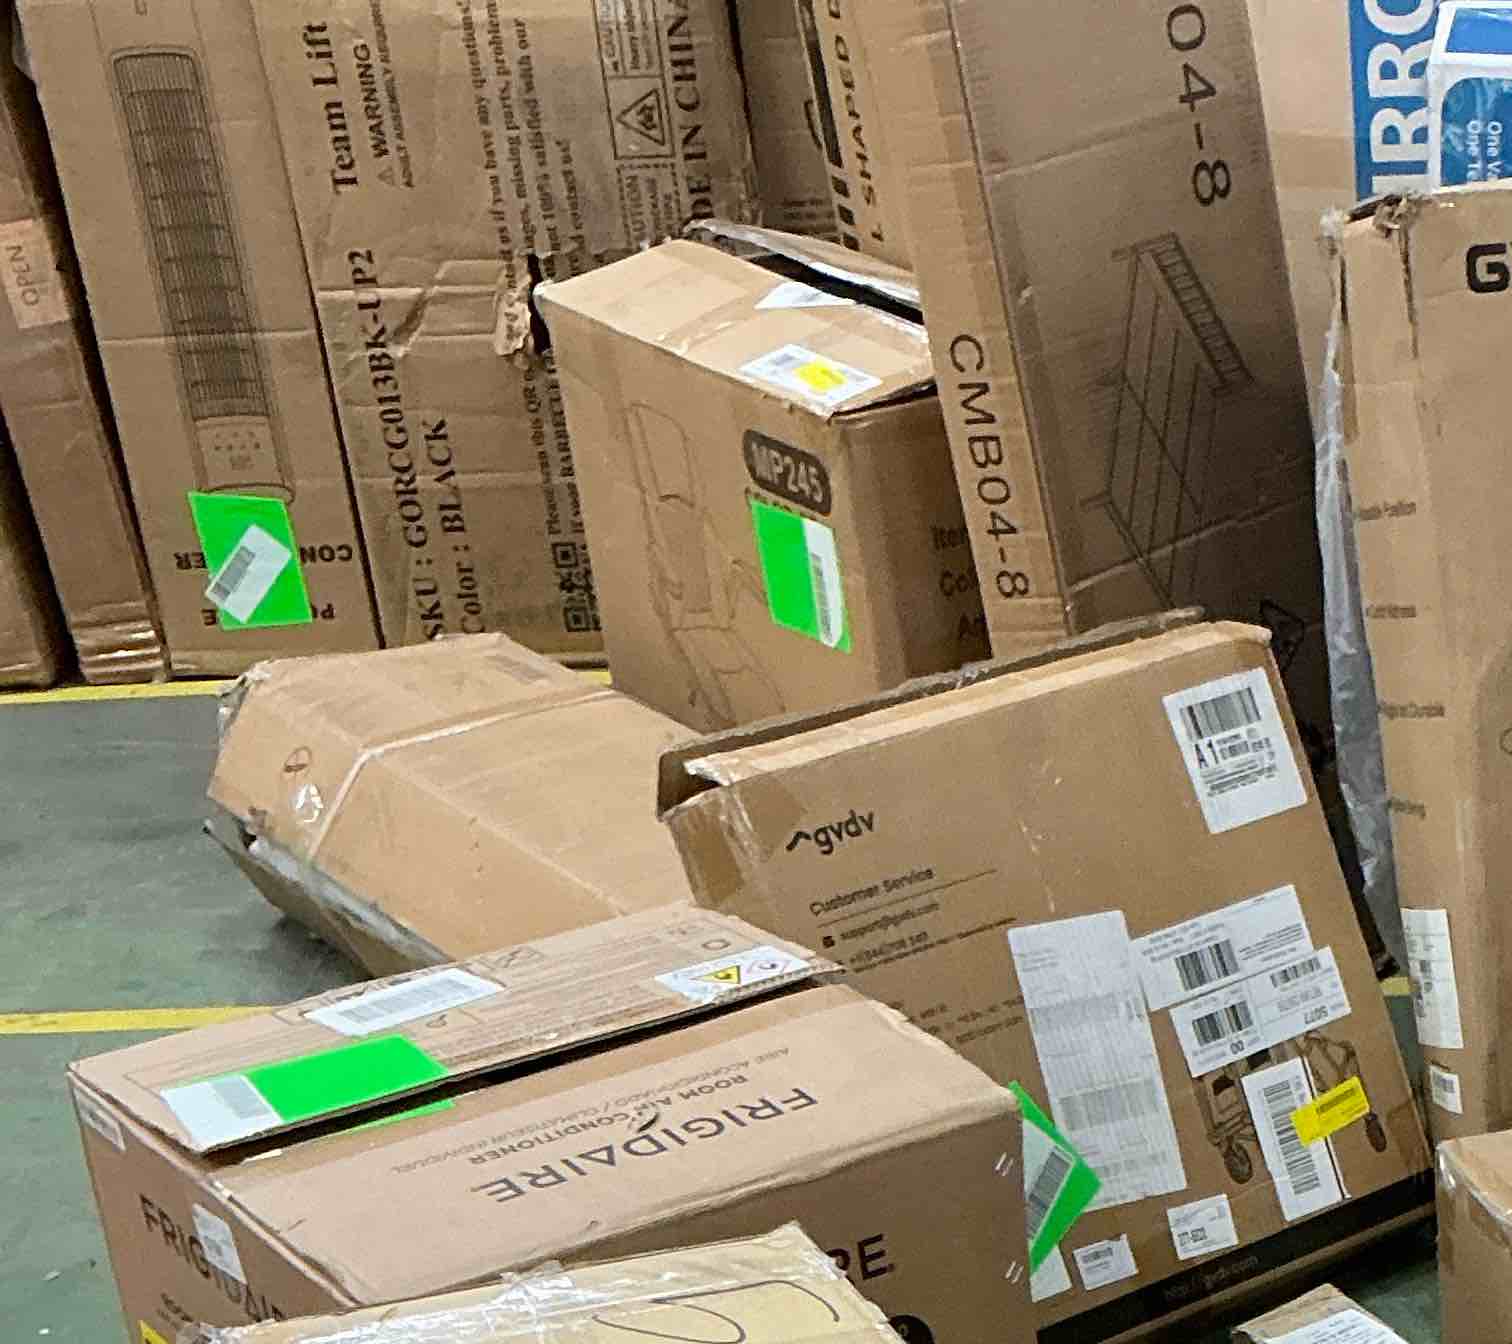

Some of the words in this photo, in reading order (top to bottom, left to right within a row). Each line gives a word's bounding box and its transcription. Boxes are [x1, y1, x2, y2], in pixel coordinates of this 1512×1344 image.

[302, 21, 338, 87] Lift
[353, 43, 391, 158] WARNING
[324, 101, 359, 195] Team
[680, 124, 708, 161] IN
[5, 243, 40, 307] OPEN
[422, 416, 466, 534] BLACK
[947, 333, 1030, 600] CMB04-8
[414, 576, 445, 641] SKU
[456, 562, 487, 635] Color
[813, 809, 875, 855] gvdv
[809, 883, 879, 917] Customer
[882, 867, 935, 893] Service
[679, 1074, 750, 1101] ROOM
[478, 1087, 820, 1203] FRIGIDAIRE
